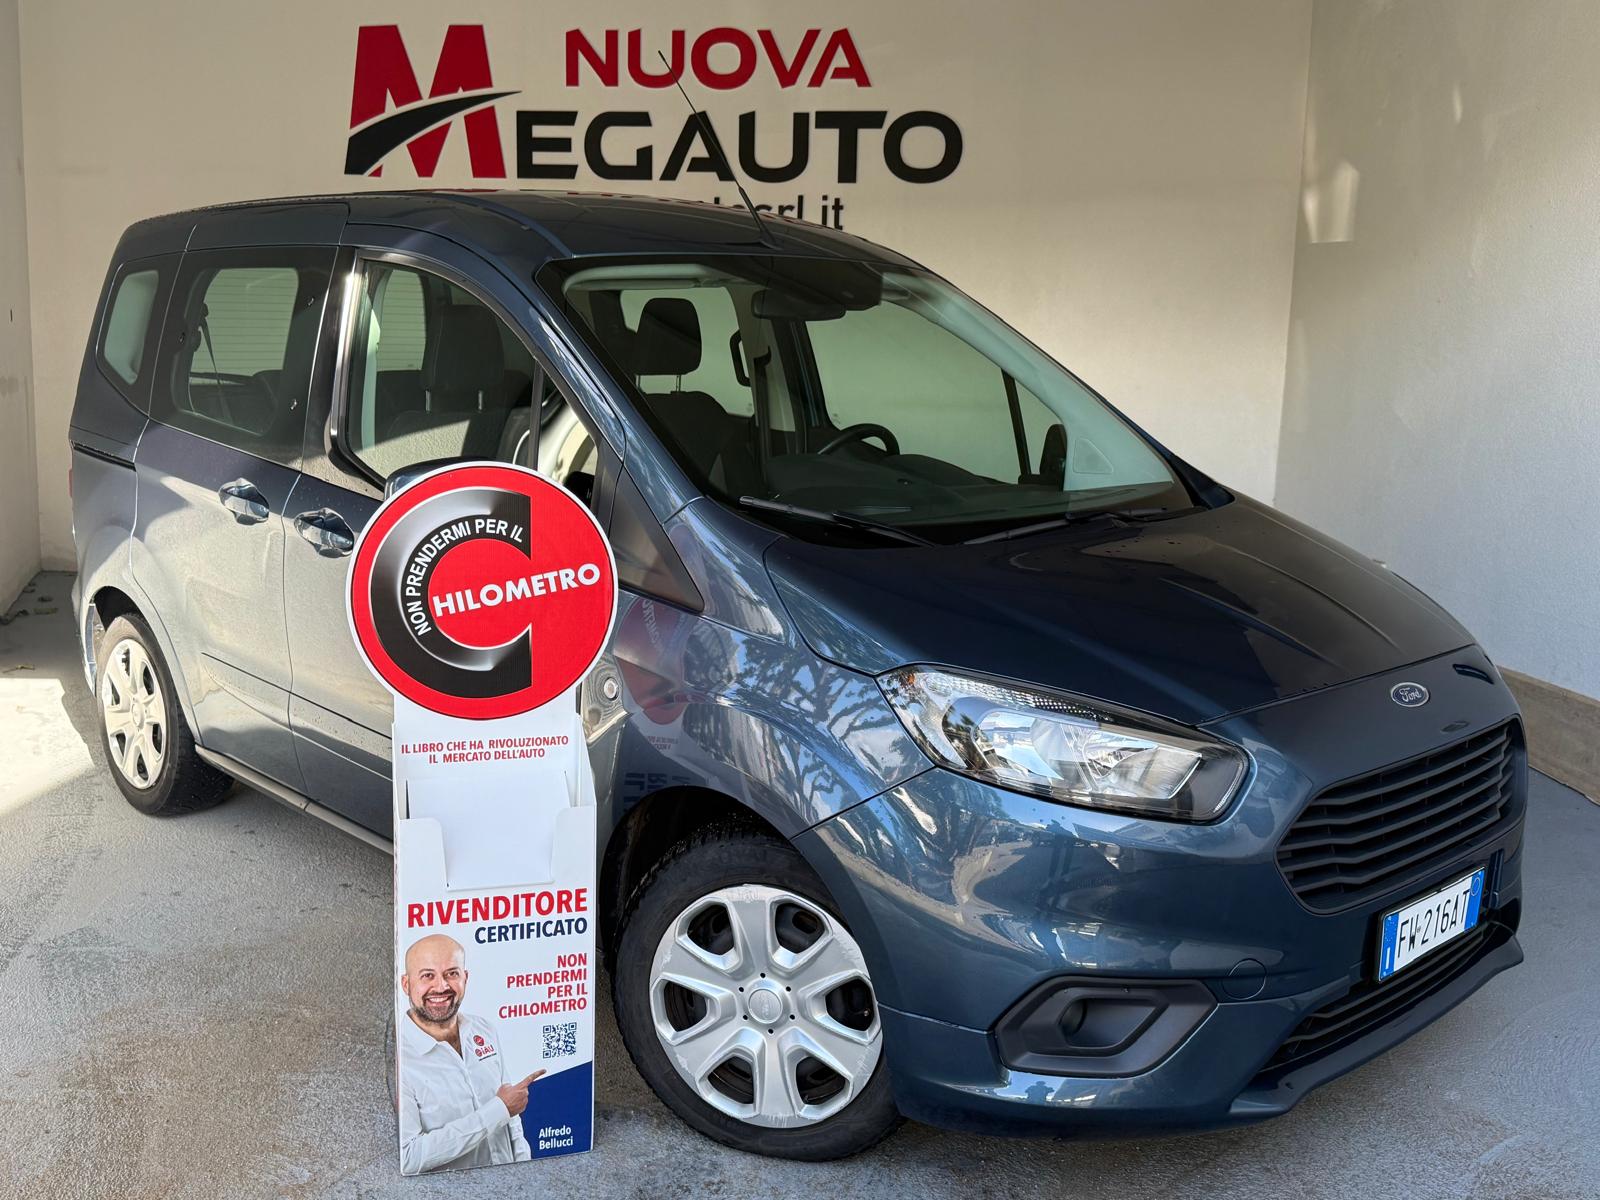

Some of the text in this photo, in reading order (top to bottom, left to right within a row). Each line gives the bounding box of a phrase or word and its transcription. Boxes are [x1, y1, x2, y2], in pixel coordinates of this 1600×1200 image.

[565, 28, 873, 90] NUOVA
[406, 518, 523, 636] NON PRENDERMI PER IL
[401, 735, 569, 754] IL LIBRO CHE HA RIVOLUZIONATO
[429, 748, 545, 764] IL MERCATO DELL'AUTO
[407, 888, 588, 928] RIVENDITORE
[474, 917, 588, 944] CERTIFICATO
[557, 953, 588, 968] NON
[507, 970, 588, 988] PRENDERMI
[547, 984, 588, 998] PER IL
[499, 998, 588, 1019] CHILOMETRO
[539, 1126, 572, 1138] Alfredo
[539, 1136, 573, 1150] Bellucci
